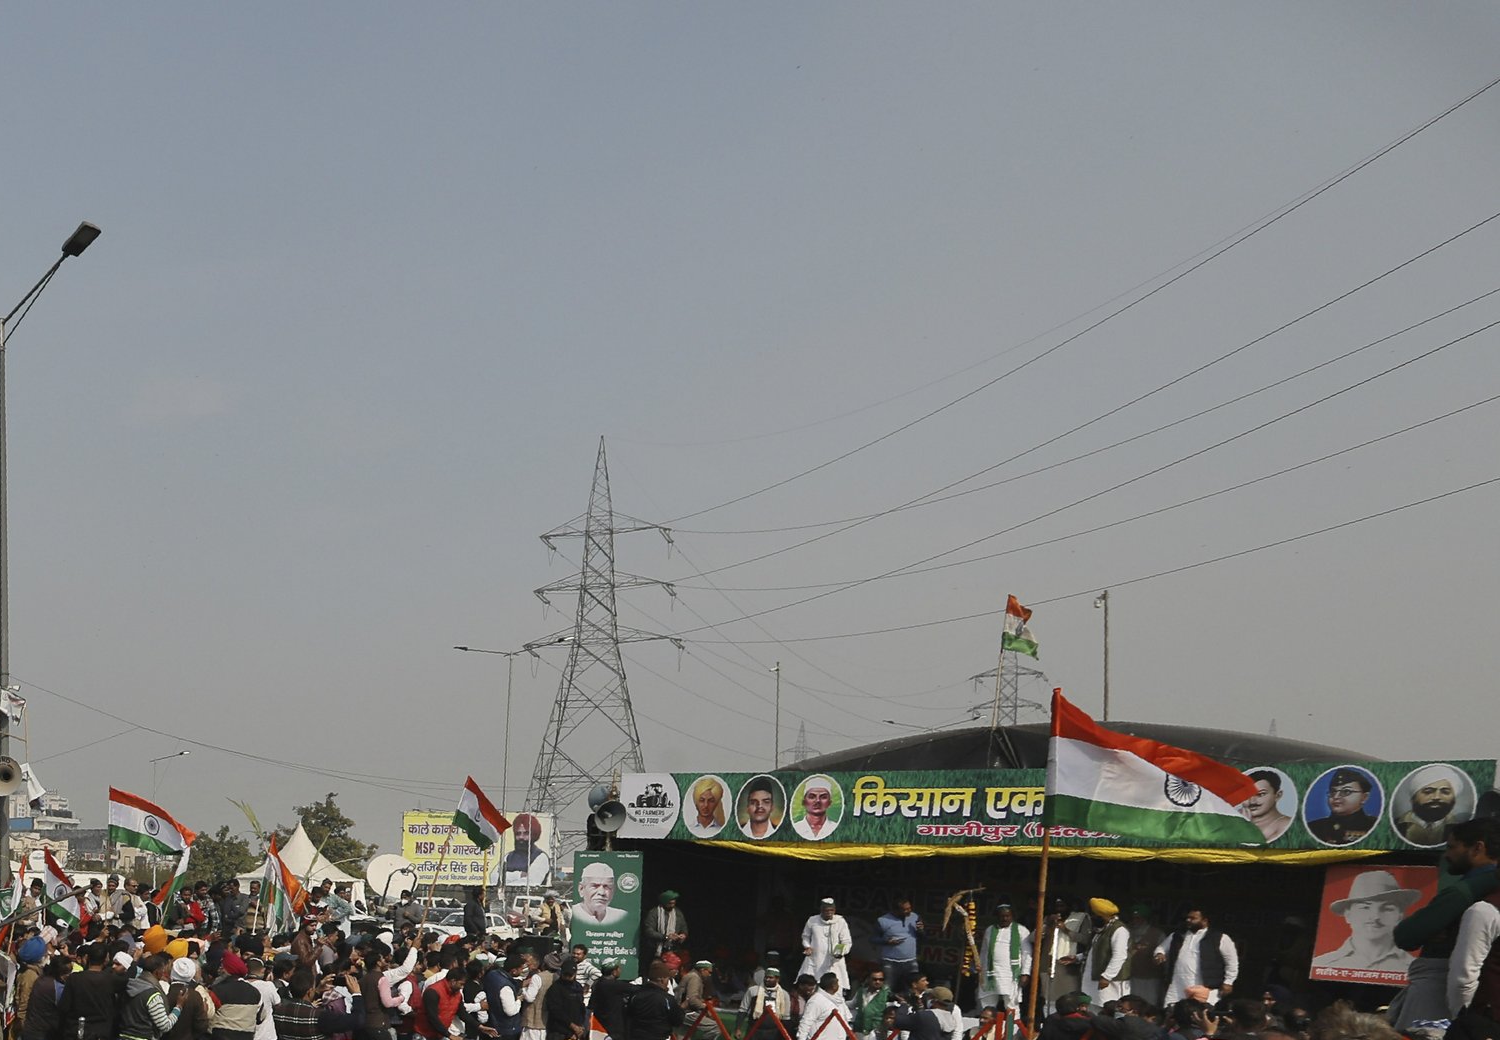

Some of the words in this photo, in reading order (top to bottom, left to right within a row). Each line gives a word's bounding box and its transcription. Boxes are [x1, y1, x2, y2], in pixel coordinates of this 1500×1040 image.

[852, 775, 977, 818] किसान
[985, 786, 1045, 818] एक
[408, 821, 430, 834] काले
[431, 824, 459, 834] कानन
[916, 820, 1020, 842] गाजीपुर
[415, 841, 435, 854] MSP
[450, 861, 467, 874] सिंह
